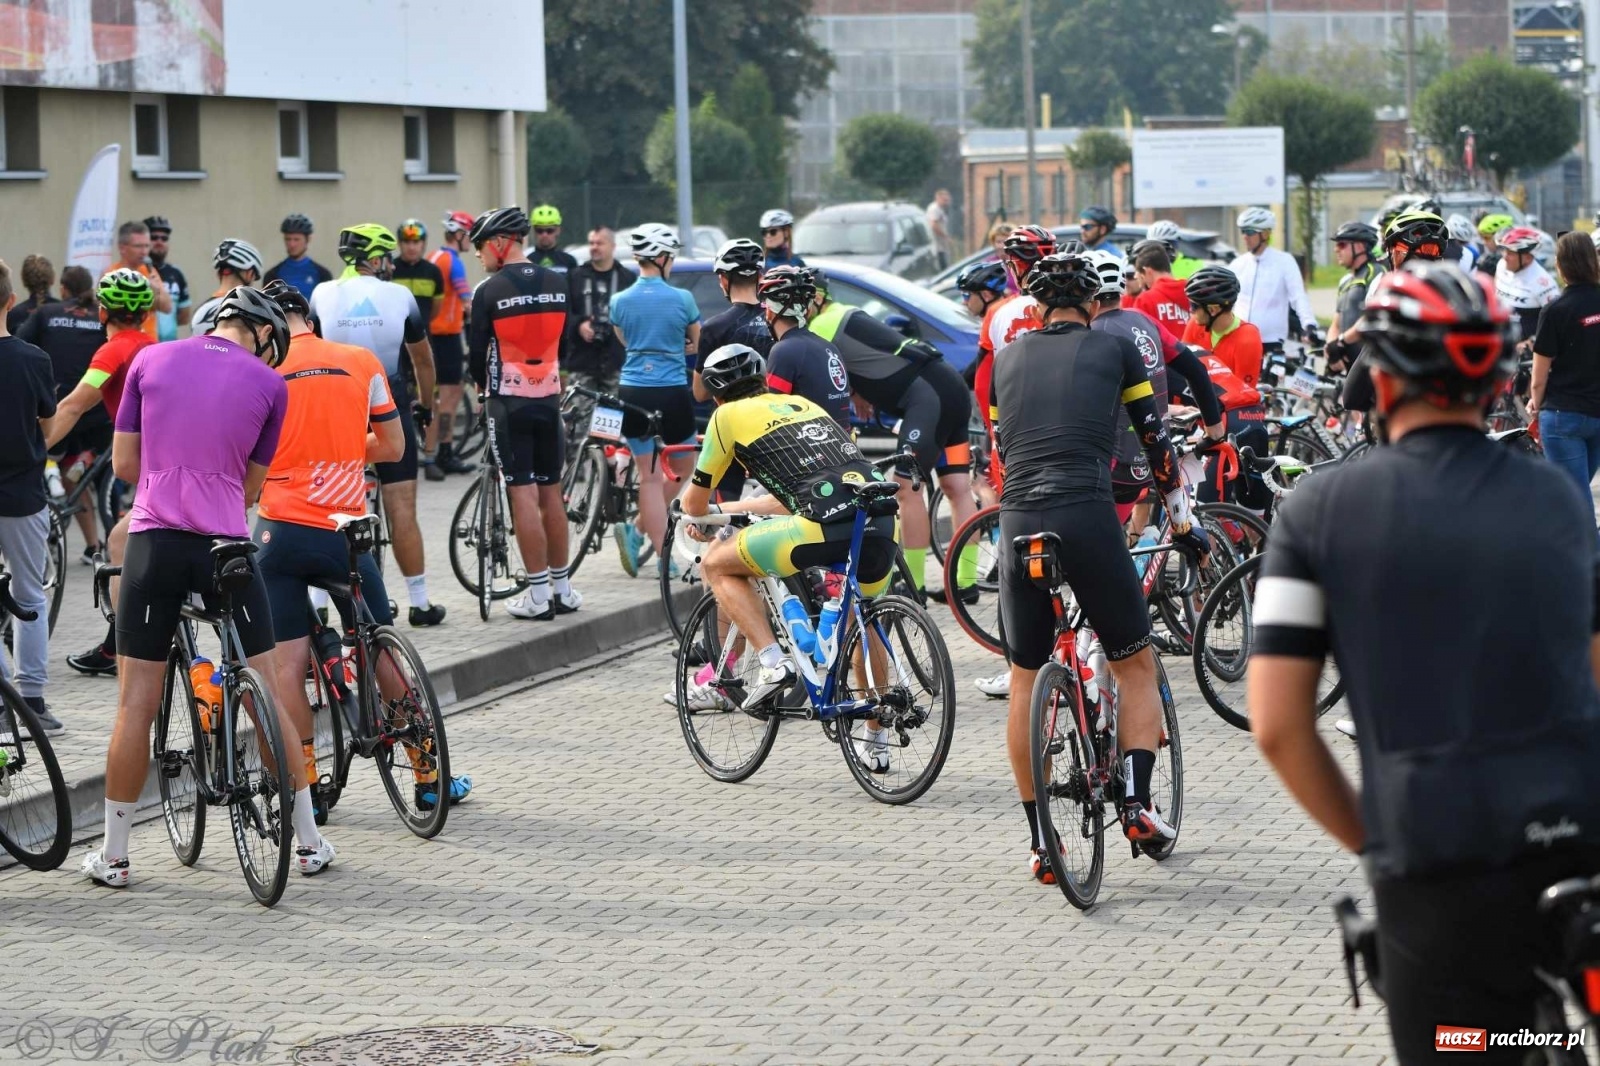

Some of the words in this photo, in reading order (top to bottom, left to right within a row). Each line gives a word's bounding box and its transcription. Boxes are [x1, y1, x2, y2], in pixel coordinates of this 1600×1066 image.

[496, 293, 566, 310] DAR-BUD
[594, 416, 621, 430] 2112
[1112, 635, 1150, 659] RACING
